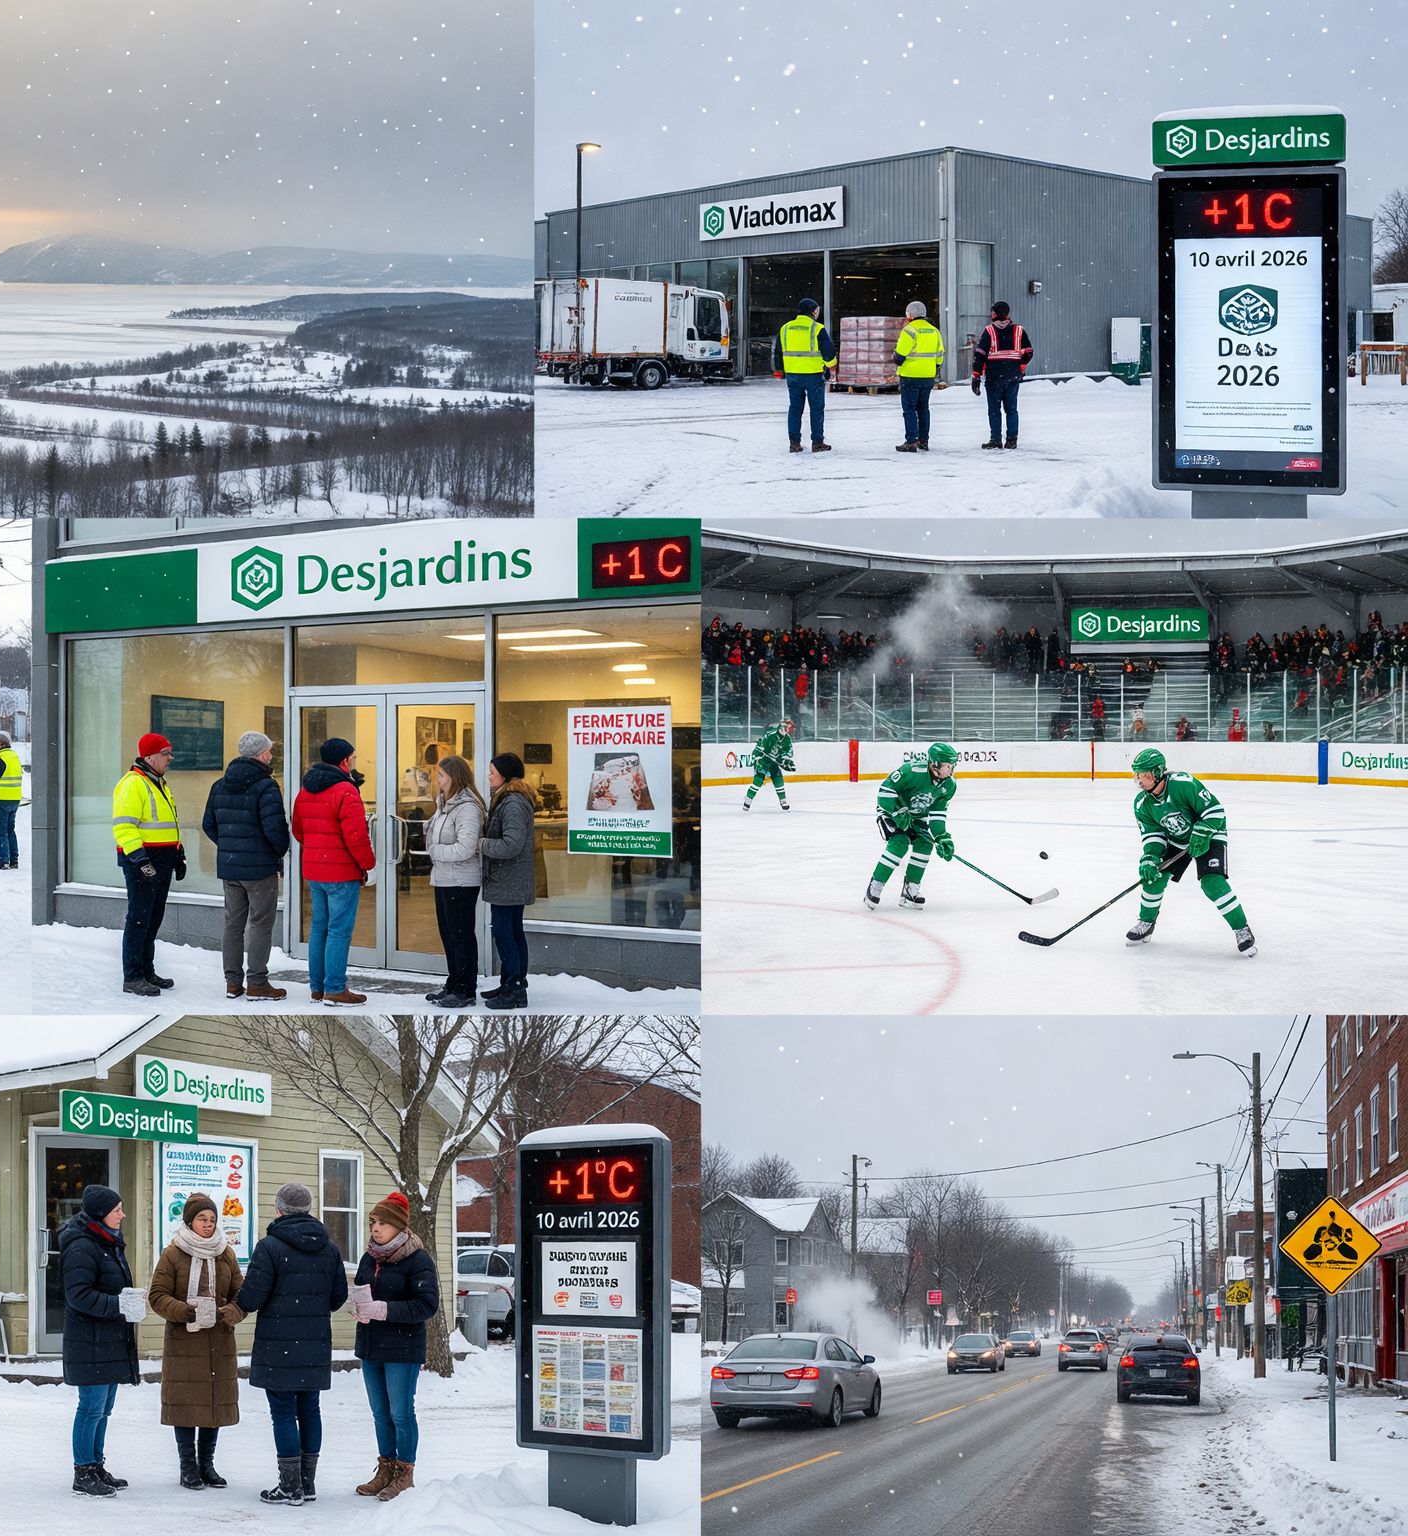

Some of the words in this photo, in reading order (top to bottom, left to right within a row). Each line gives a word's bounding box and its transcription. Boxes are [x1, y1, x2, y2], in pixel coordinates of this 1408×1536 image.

[1205, 126, 1330, 156] Desjardins
[728, 201, 837, 230] Viadomax
[1189, 251, 1210, 268] 10
[1215, 250, 1255, 267] avril
[1260, 250, 1308, 267] 2026
[1217, 364, 1280, 387] 2026
[297, 539, 533, 601] Desjardins
[1107, 614, 1201, 638] Desjardins
[573, 713, 665, 729] FERMETURE
[573, 730, 666, 745] TEMPORAIRE
[173, 1069, 265, 1104] Desjardins
[99, 1103, 194, 1137] Desjardins
[549, 1160, 635, 1200] +1°C
[536, 1212, 555, 1229] 10
[558, 1211, 593, 1229] avril
[597, 1210, 640, 1228] 2026
